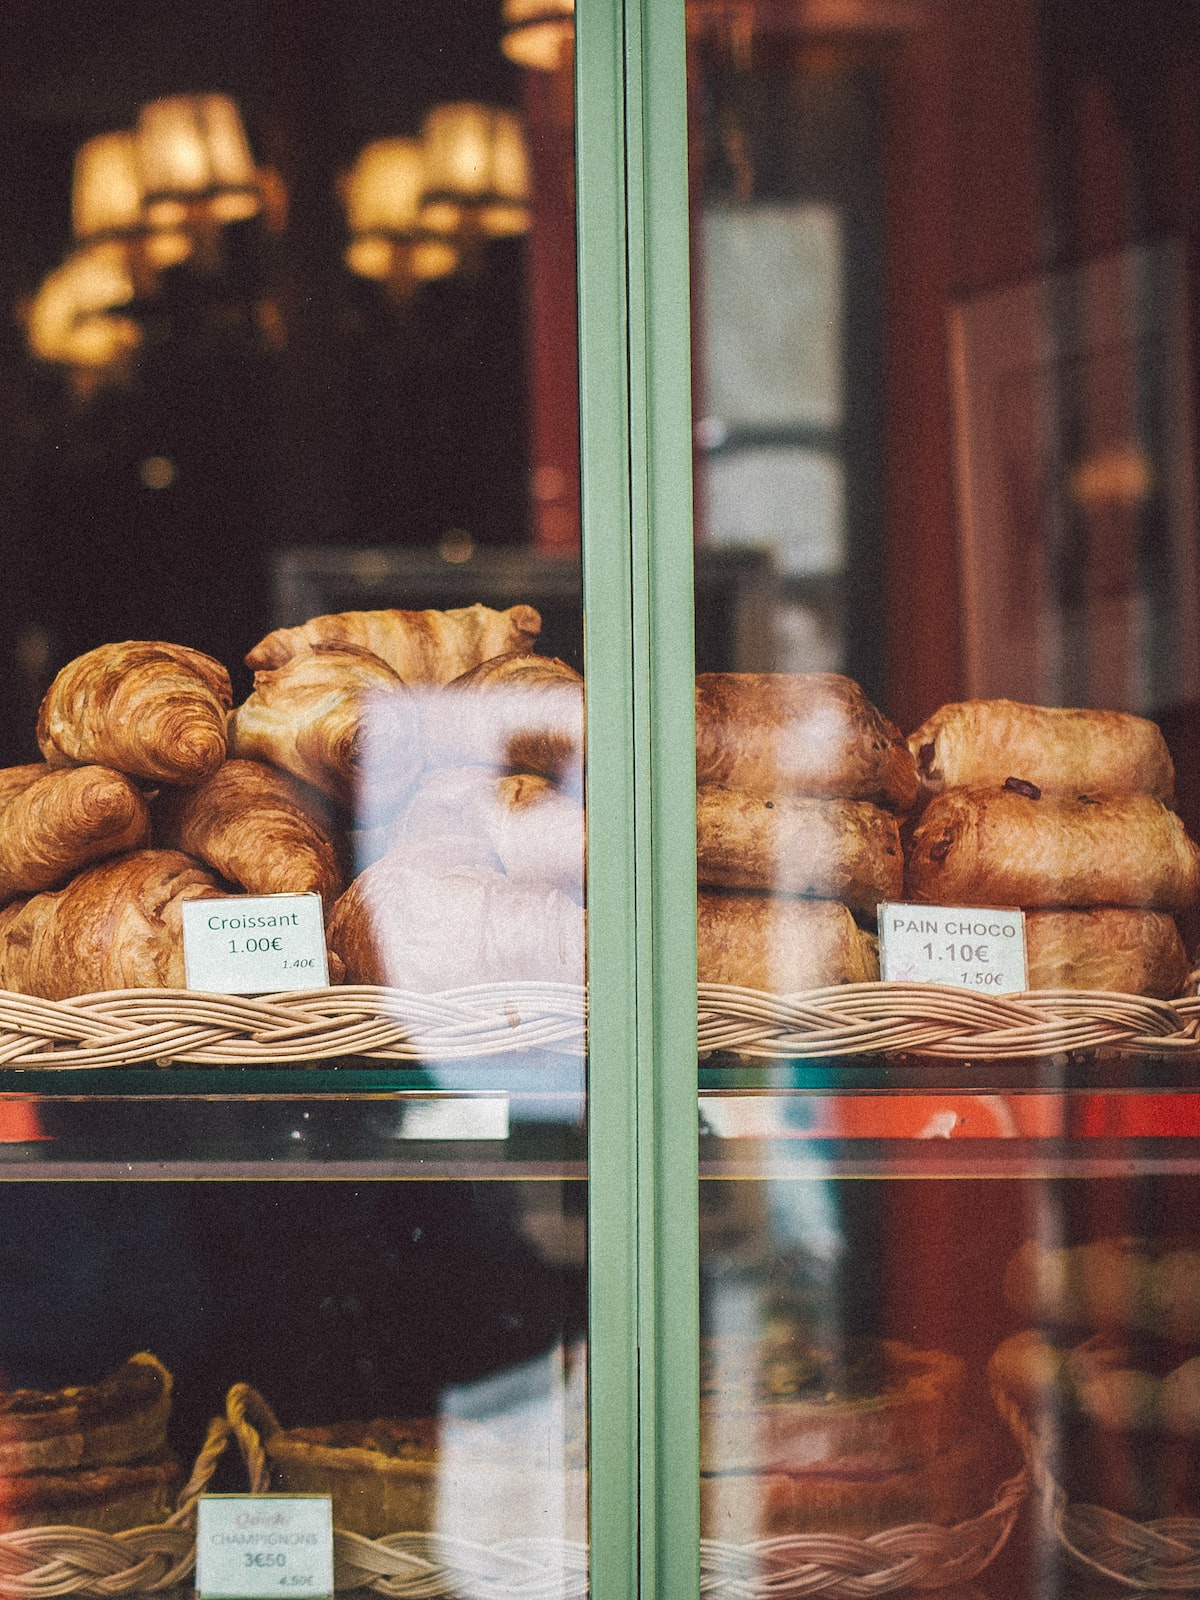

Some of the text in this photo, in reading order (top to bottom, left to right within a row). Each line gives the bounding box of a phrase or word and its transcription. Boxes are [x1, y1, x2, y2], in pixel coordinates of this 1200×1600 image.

[207, 912, 300, 931] Croissant
[893, 919, 1017, 938] PAIN CHOCO
[228, 937, 284, 954] 1.00€
[923, 942, 990, 963] 1.10€
[282, 958, 316, 970] 1.40€
[960, 971, 1004, 986] 1.50€
[210, 1531, 319, 1546] CHAMPIGNONS
[243, 1552, 288, 1568] 3€50
